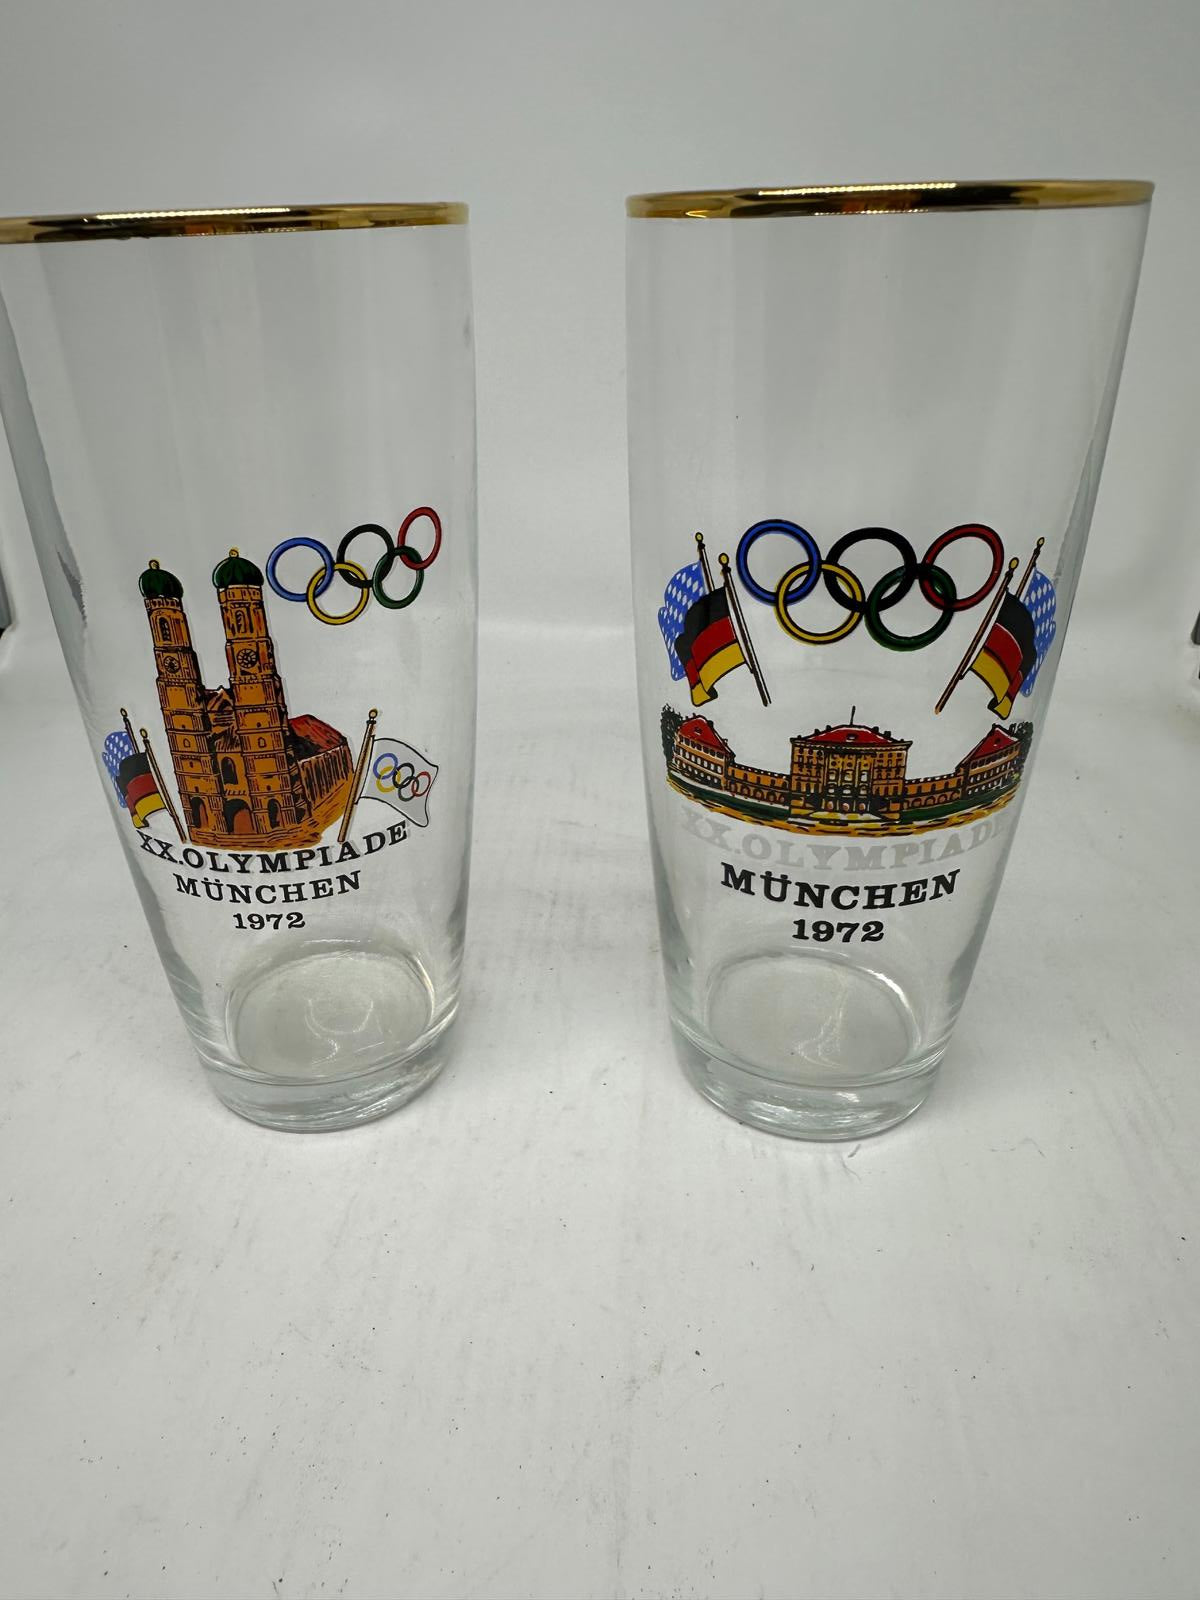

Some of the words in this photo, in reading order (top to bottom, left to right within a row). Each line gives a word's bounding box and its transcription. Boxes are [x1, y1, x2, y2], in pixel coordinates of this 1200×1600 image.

[173, 870, 362, 904] MÜNCHEN
[721, 861, 961, 910] MÜNCHEN
[233, 911, 306, 930] 1972
[791, 919, 885, 943] 1972
